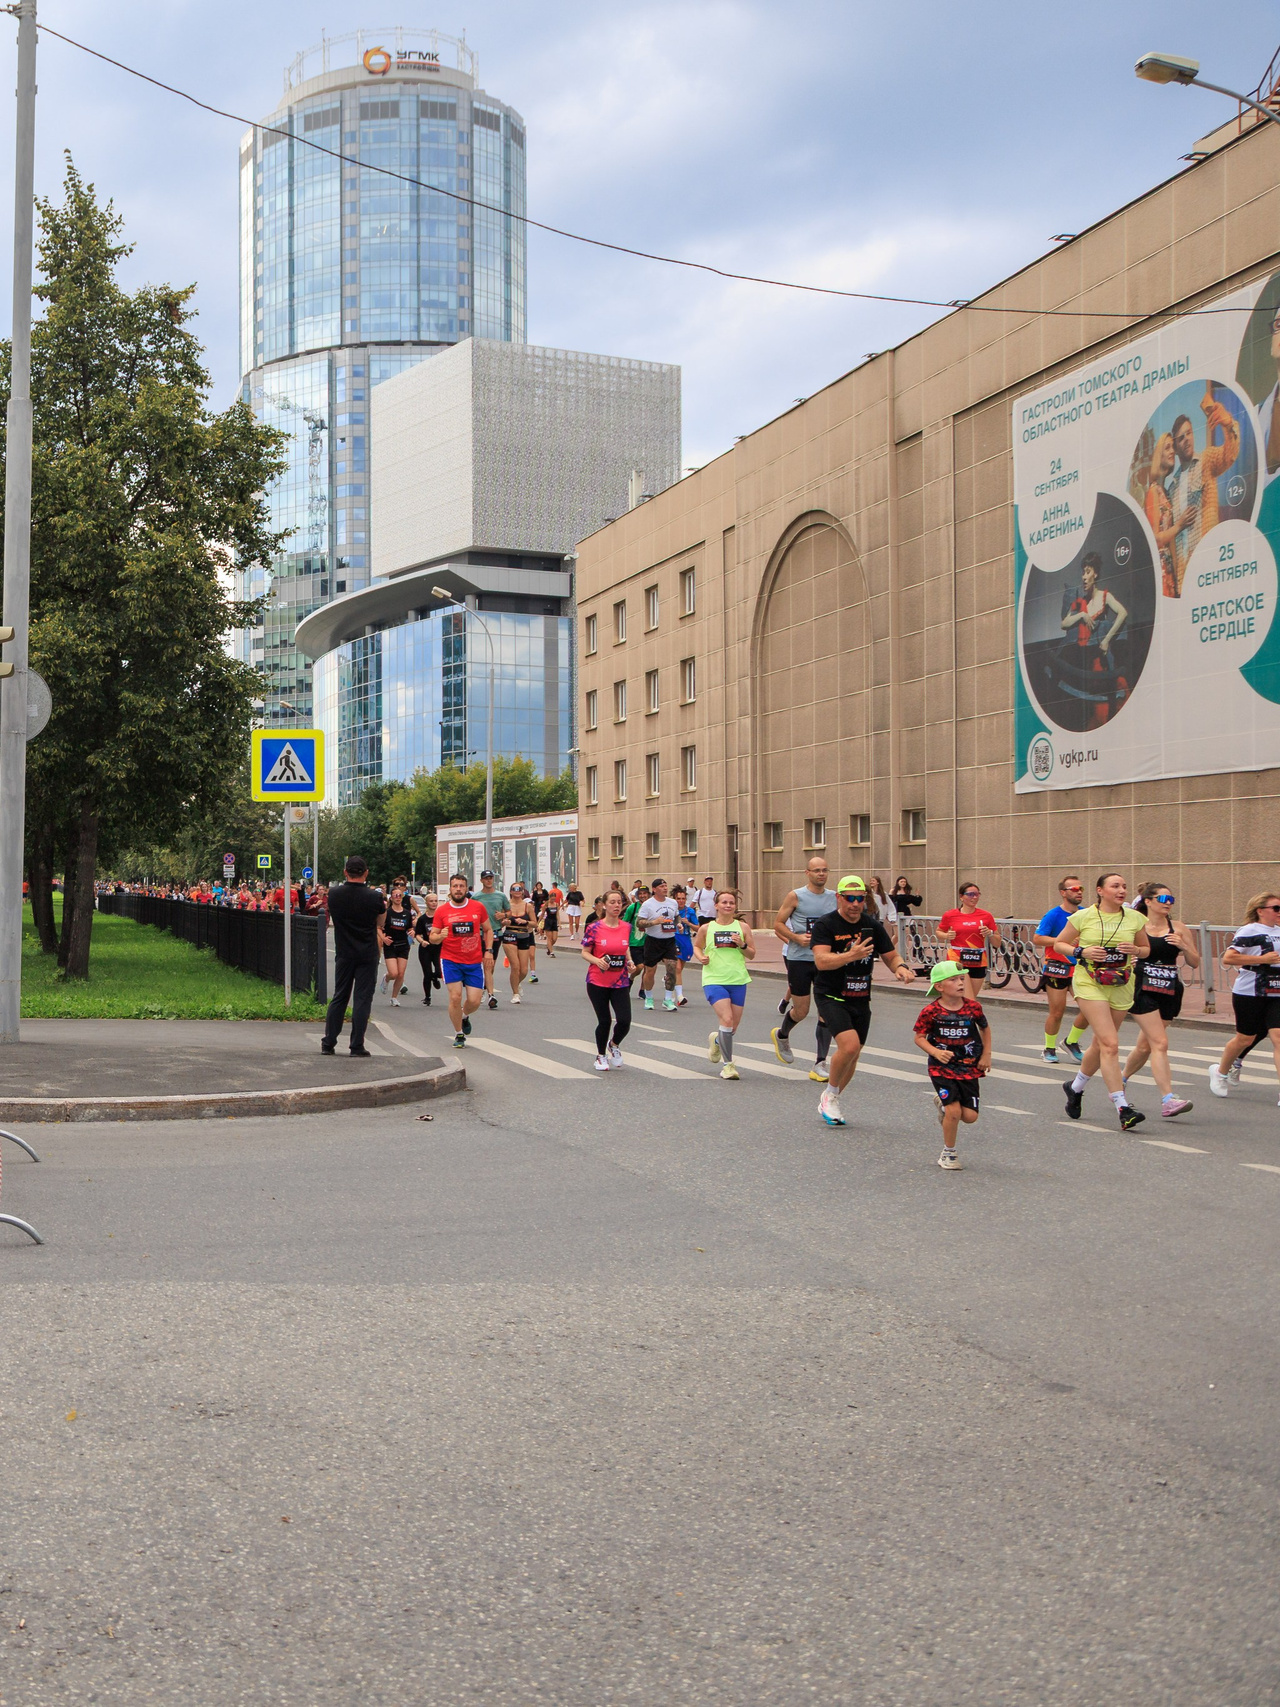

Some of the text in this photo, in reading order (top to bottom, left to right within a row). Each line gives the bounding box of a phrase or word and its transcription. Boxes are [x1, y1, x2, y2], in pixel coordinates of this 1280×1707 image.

[396, 50, 440, 62] УГМК
[1022, 355, 1143, 425] ГАСТРОЛИ ТОМСКОГО
[1022, 355, 1191, 444] ОБЛАСТНОГО ТЕАТРА ДРАМЫ
[1050, 457, 1062, 476] 24
[1034, 470, 1079, 498] СЕНТЯБРЯ
[1228, 485, 1245, 499] 12+
[1042, 502, 1071, 525] АННА
[1029, 515, 1085, 547] КАРЕНИНА
[1115, 546, 1130, 558] 16+
[1219, 543, 1235, 562] 25
[1197, 561, 1259, 588] СЕНТЯБРЯ
[1191, 592, 1265, 625] БРАТСКОЕ
[1199, 617, 1256, 644] СЕРДЦЕ
[1059, 748, 1099, 769] vgkp.ru
[1048, 966, 1066, 975] 16741
[1148, 977, 1171, 987] 15197
[939, 1027, 969, 1036] 15863
